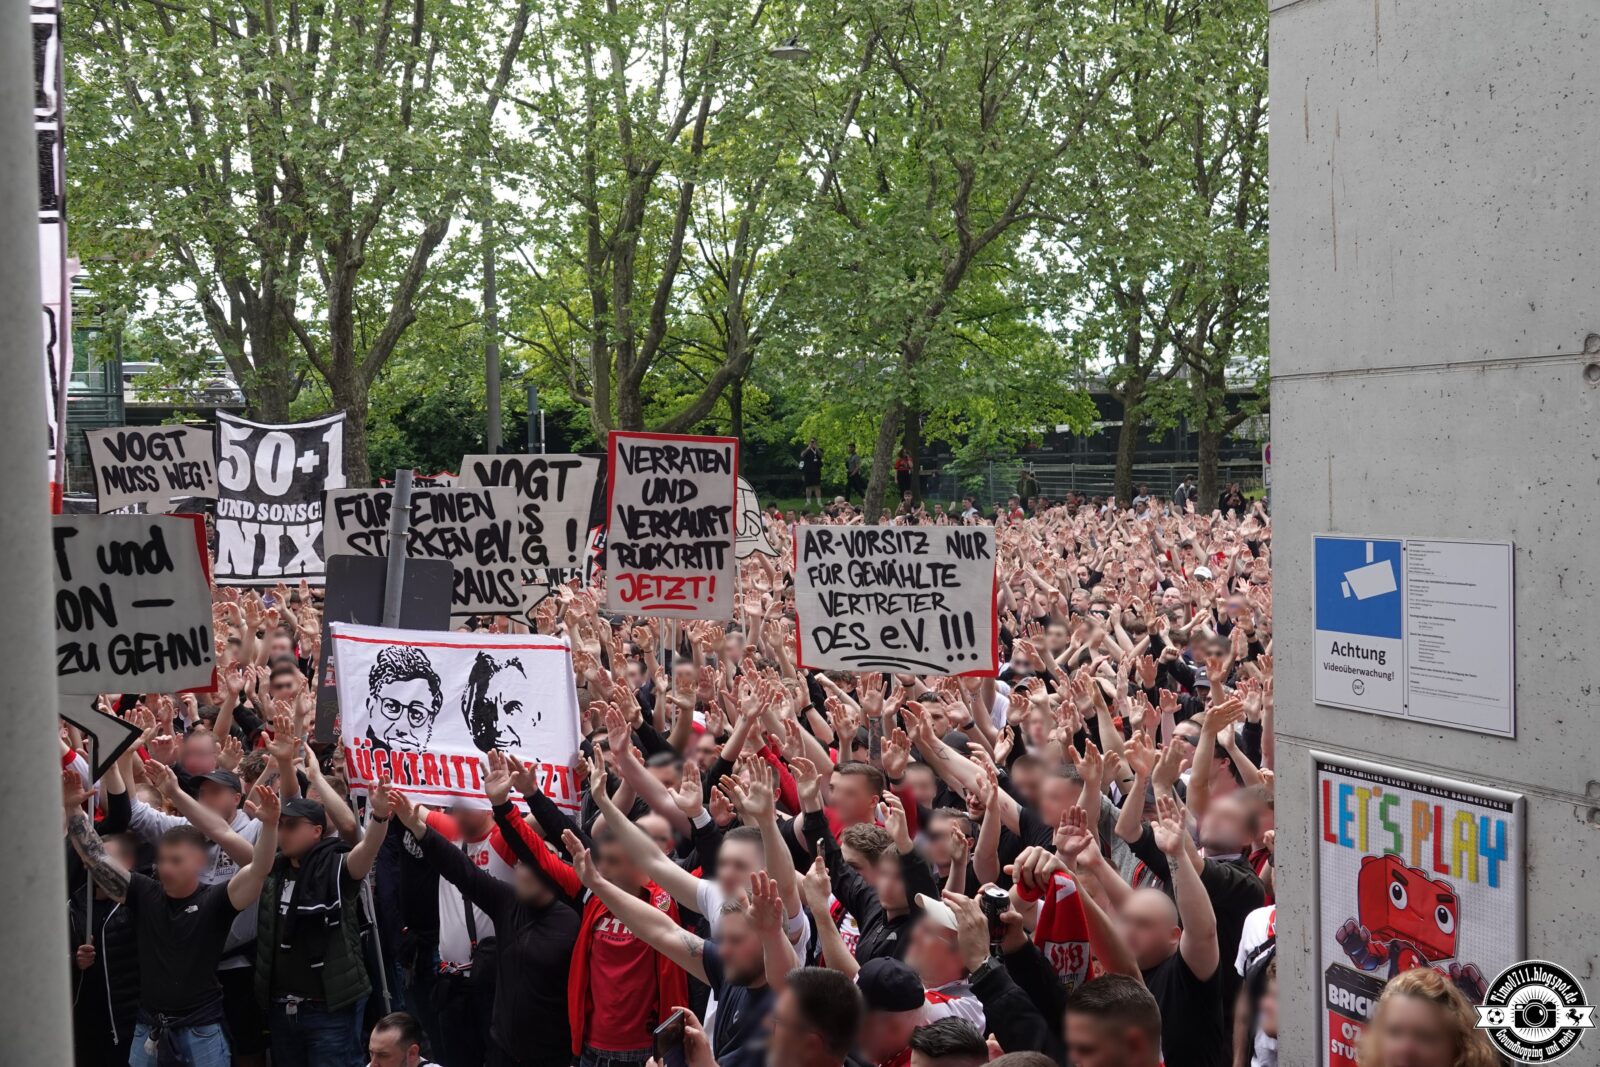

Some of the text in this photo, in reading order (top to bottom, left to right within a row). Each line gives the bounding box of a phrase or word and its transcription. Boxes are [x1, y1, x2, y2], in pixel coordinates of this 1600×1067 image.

[103, 429, 187, 463] VOGT
[217, 420, 347, 497] 50+1
[617, 442, 731, 475] VERRATEN
[101, 460, 213, 496] MUSS WEG!
[474, 458, 582, 502] VOGT
[642, 477, 698, 505] UND
[216, 498, 322, 522] UND SONSC
[410, 489, 496, 527] EINEN
[616, 504, 732, 540] VERKAUFT
[96, 525, 174, 576] und
[213, 519, 325, 576] NIX
[346, 527, 475, 560] STRKEN
[610, 541, 731, 570] RÜCKTRITT
[804, 529, 990, 562] AR-VORSITZ NUR
[615, 572, 716, 602] JETZT!
[807, 558, 961, 589] FÜR GEWÄHLTE
[818, 590, 951, 617] VERTRETER
[108, 625, 211, 676] GEHN!
[812, 622, 870, 654] DES
[880, 618, 930, 653] e.V.
[1331, 641, 1386, 665] Achtung
[1323, 661, 1395, 682] Videoüberwachung!
[1322, 779, 1508, 889] LET'S PLAY
